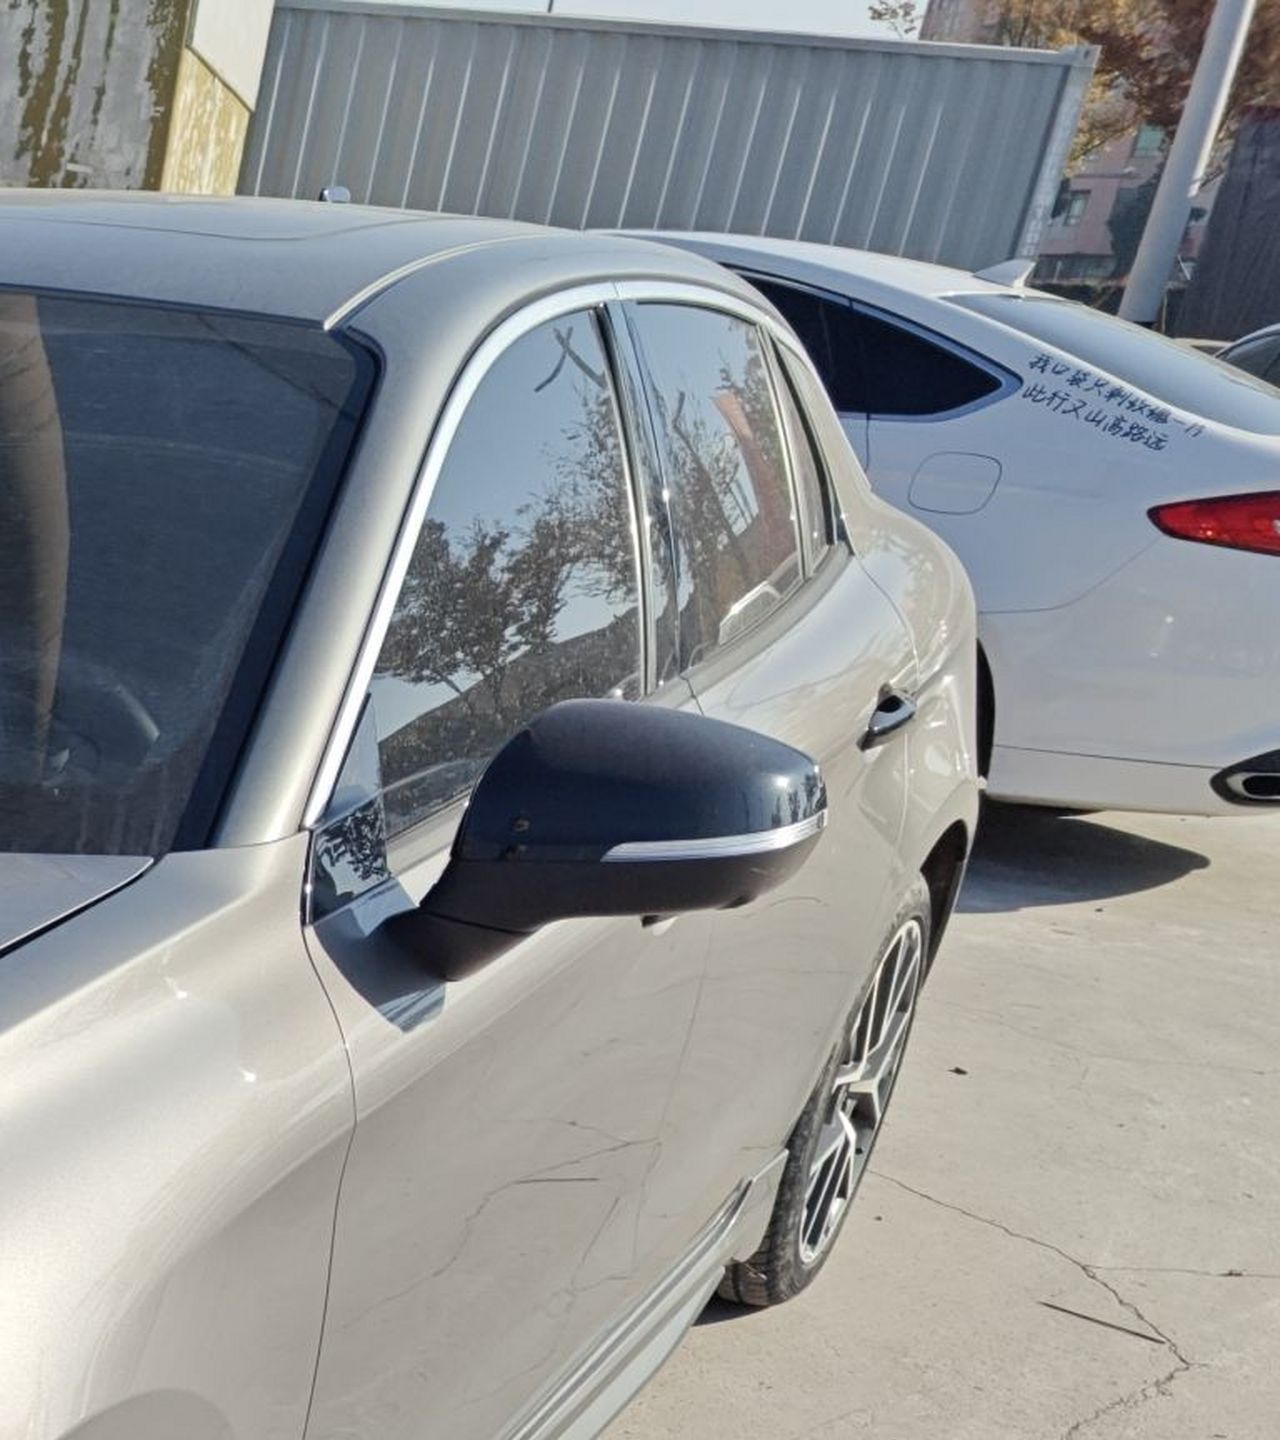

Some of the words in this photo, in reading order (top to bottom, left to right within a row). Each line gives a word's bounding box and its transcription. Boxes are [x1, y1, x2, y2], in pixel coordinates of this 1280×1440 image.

[1022, 382, 1169, 451] 此行又山高路远
